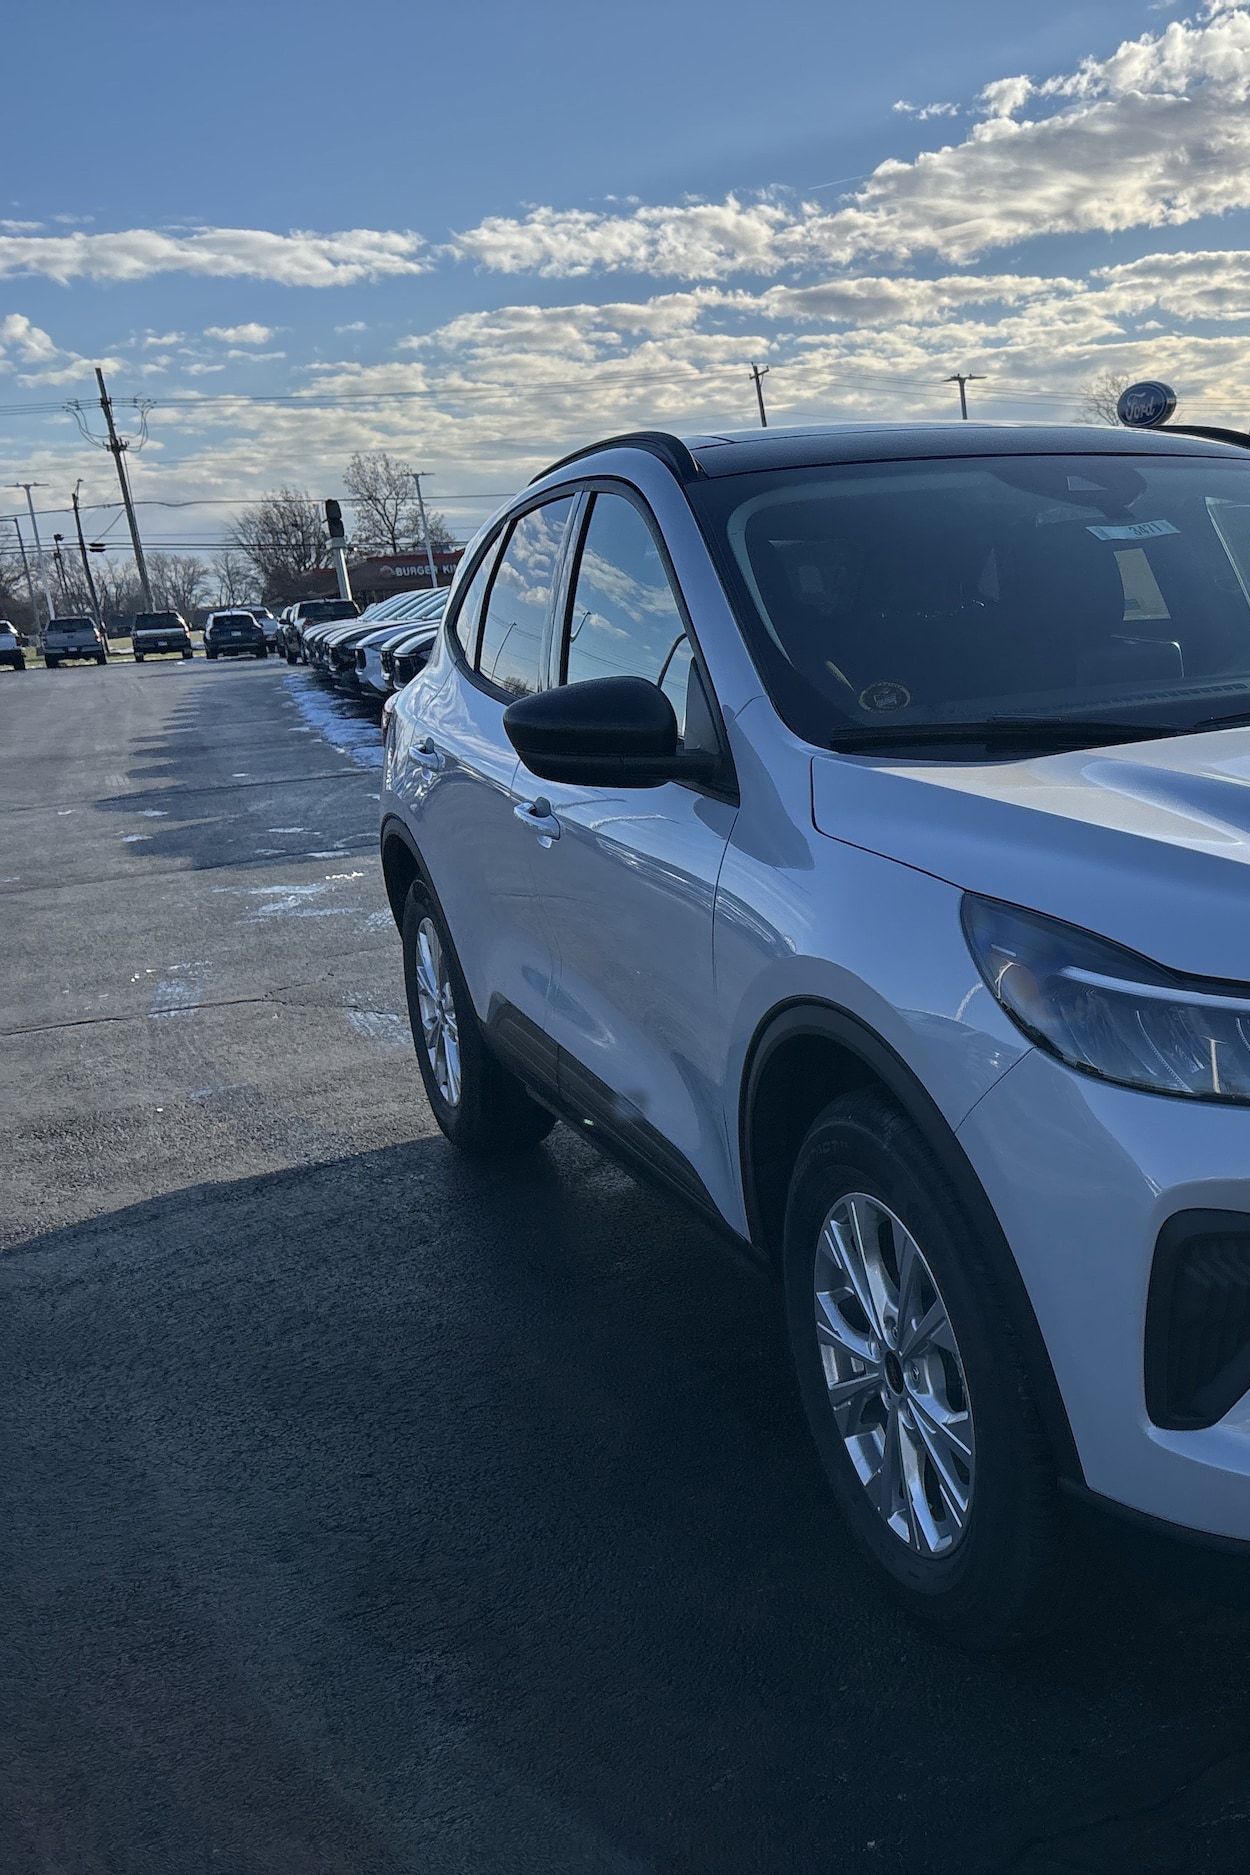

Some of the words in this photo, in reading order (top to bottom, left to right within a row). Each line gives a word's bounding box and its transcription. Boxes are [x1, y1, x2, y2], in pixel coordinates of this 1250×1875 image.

[1125, 391, 1156, 421] Ford
[1128, 522, 1162, 536] 3471
[394, 564, 439, 577] BURGER
